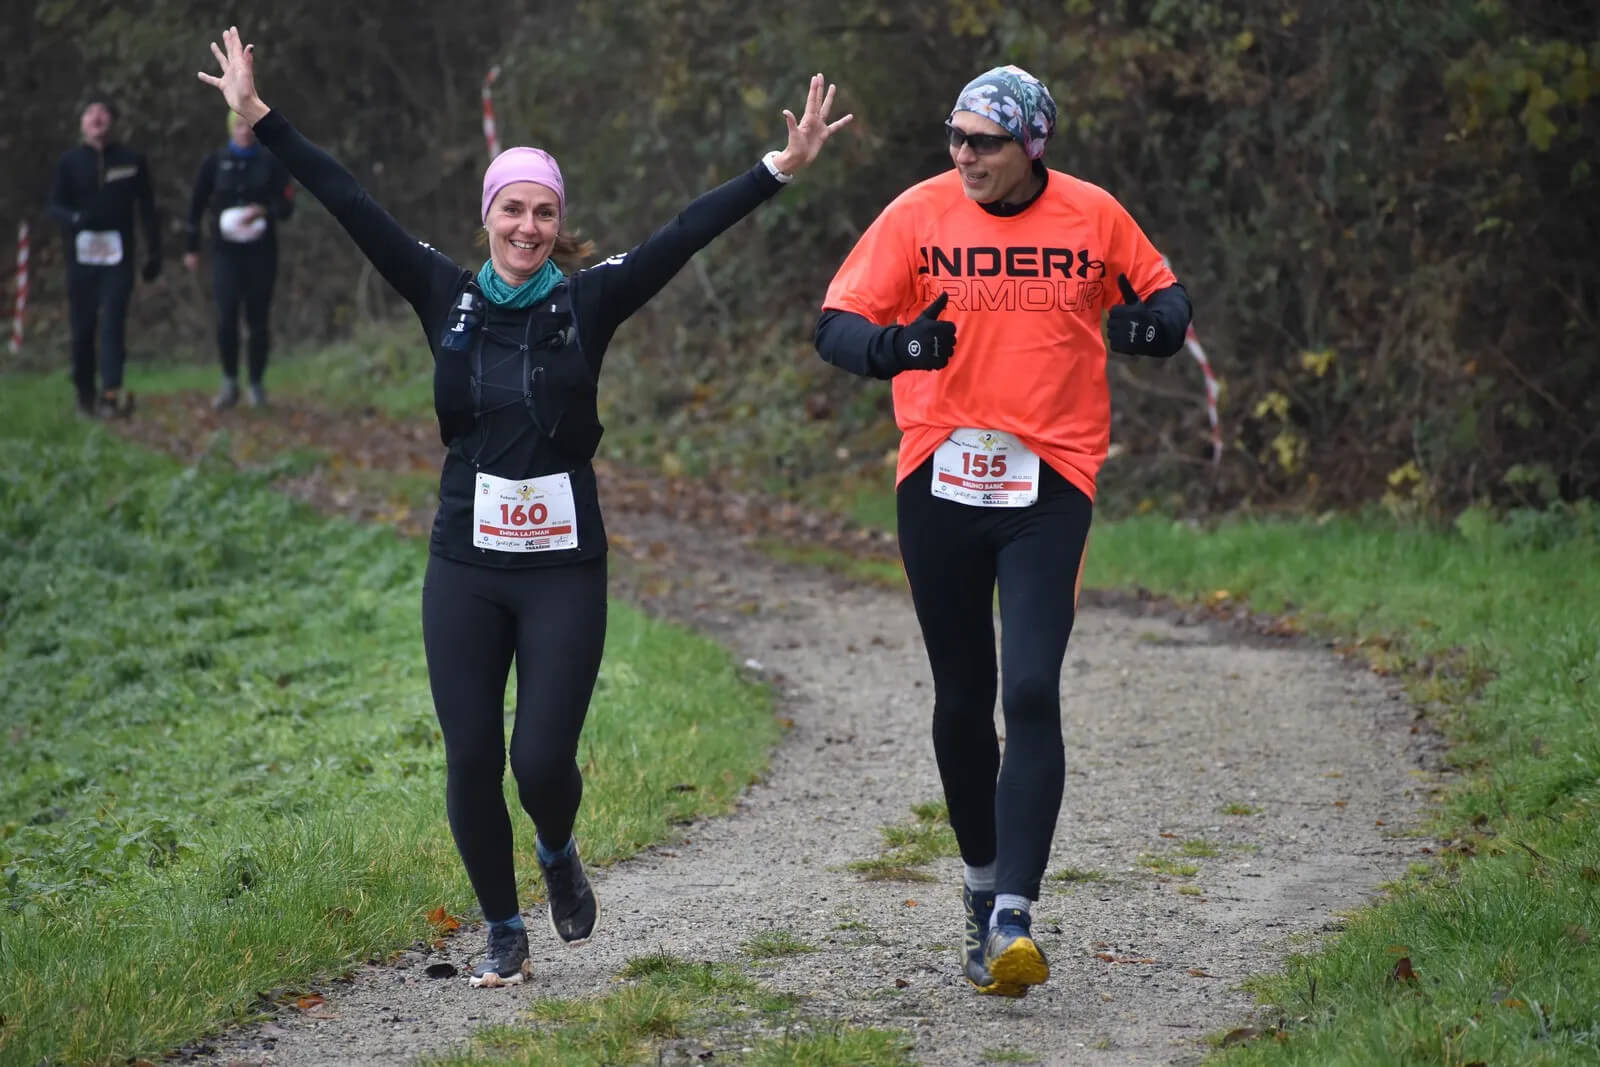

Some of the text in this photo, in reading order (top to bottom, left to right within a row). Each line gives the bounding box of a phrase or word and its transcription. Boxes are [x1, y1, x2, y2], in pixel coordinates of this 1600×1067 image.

[986, 433, 992, 441] 2
[962, 452, 1007, 478] 155
[500, 503, 548, 526] 160
[520, 529, 550, 537] LAJTMAN
